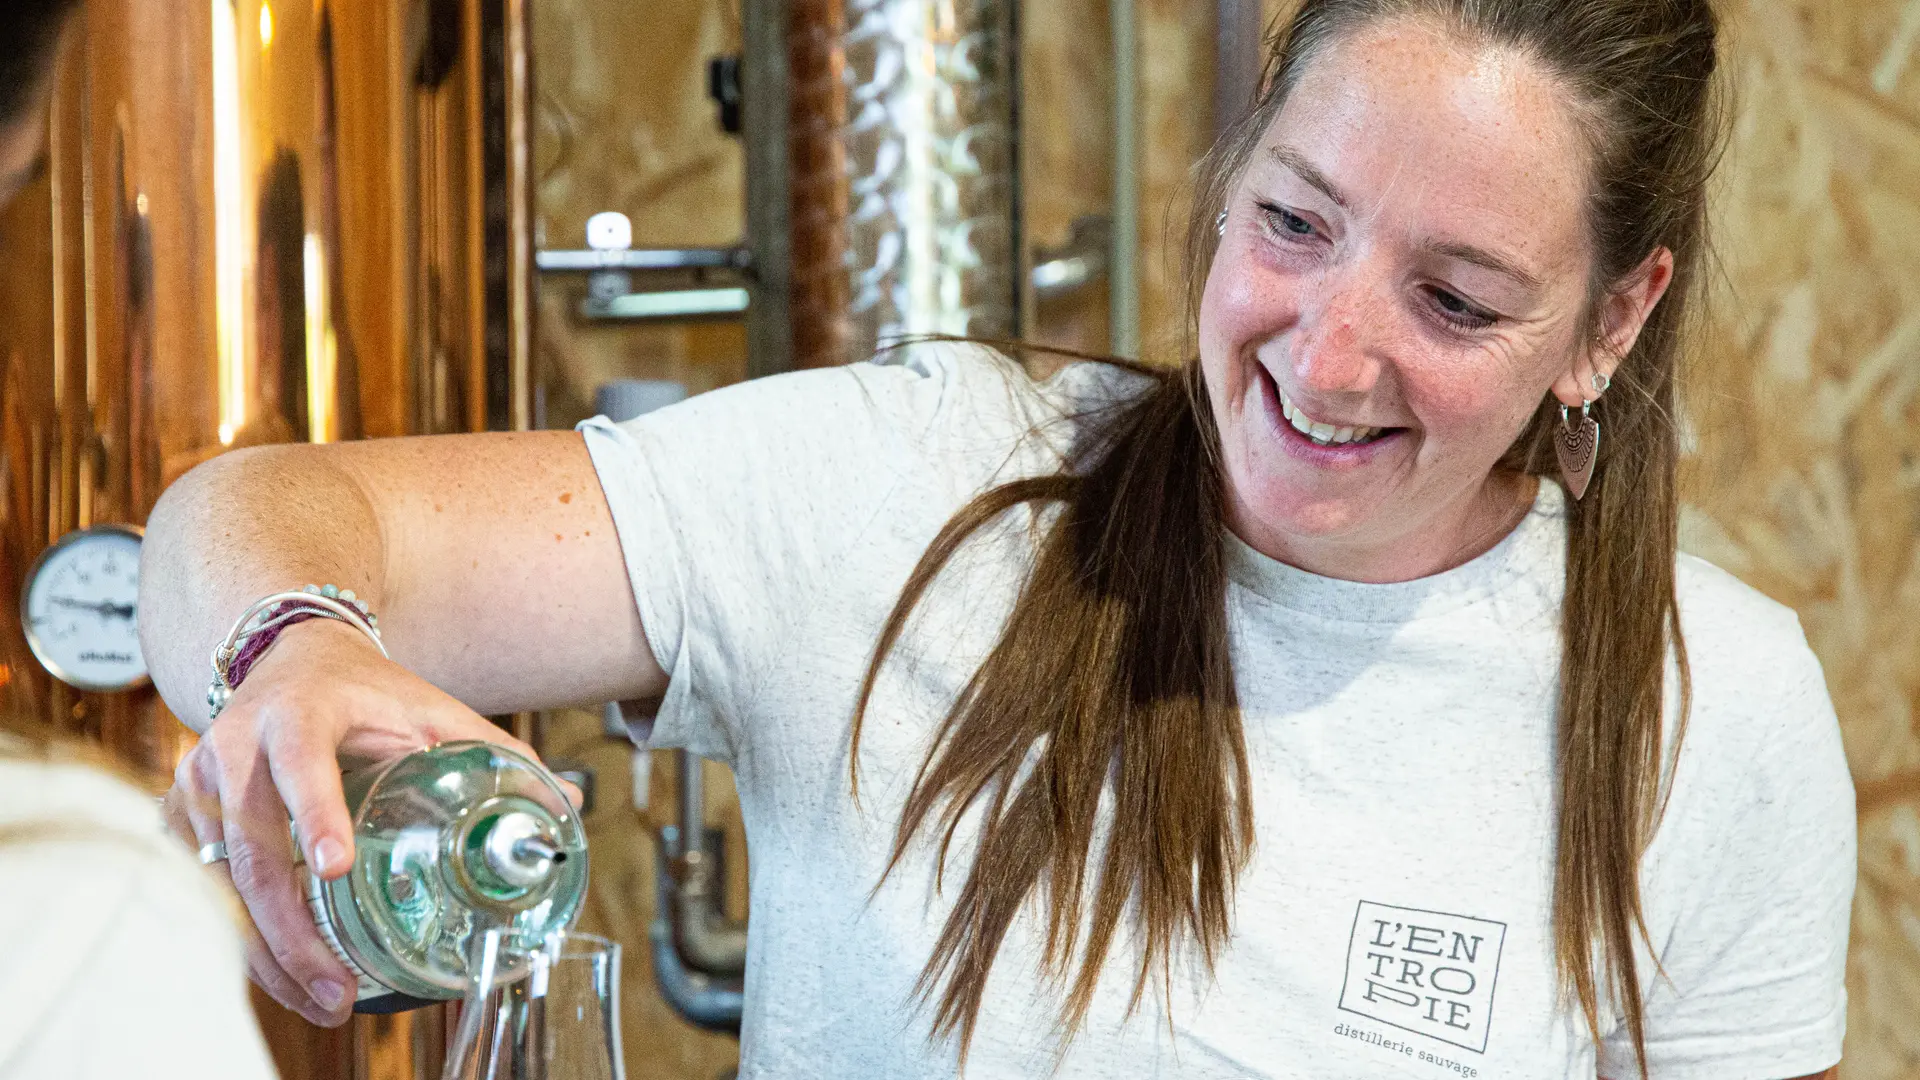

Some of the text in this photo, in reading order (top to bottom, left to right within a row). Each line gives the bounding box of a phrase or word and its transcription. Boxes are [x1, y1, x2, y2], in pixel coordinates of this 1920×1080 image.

[1369, 919, 1484, 963] L'EN
[1367, 952, 1476, 995] TRO
[1362, 978, 1471, 1030] PIE
[1334, 1023, 1478, 1079] distillerie sauvage
